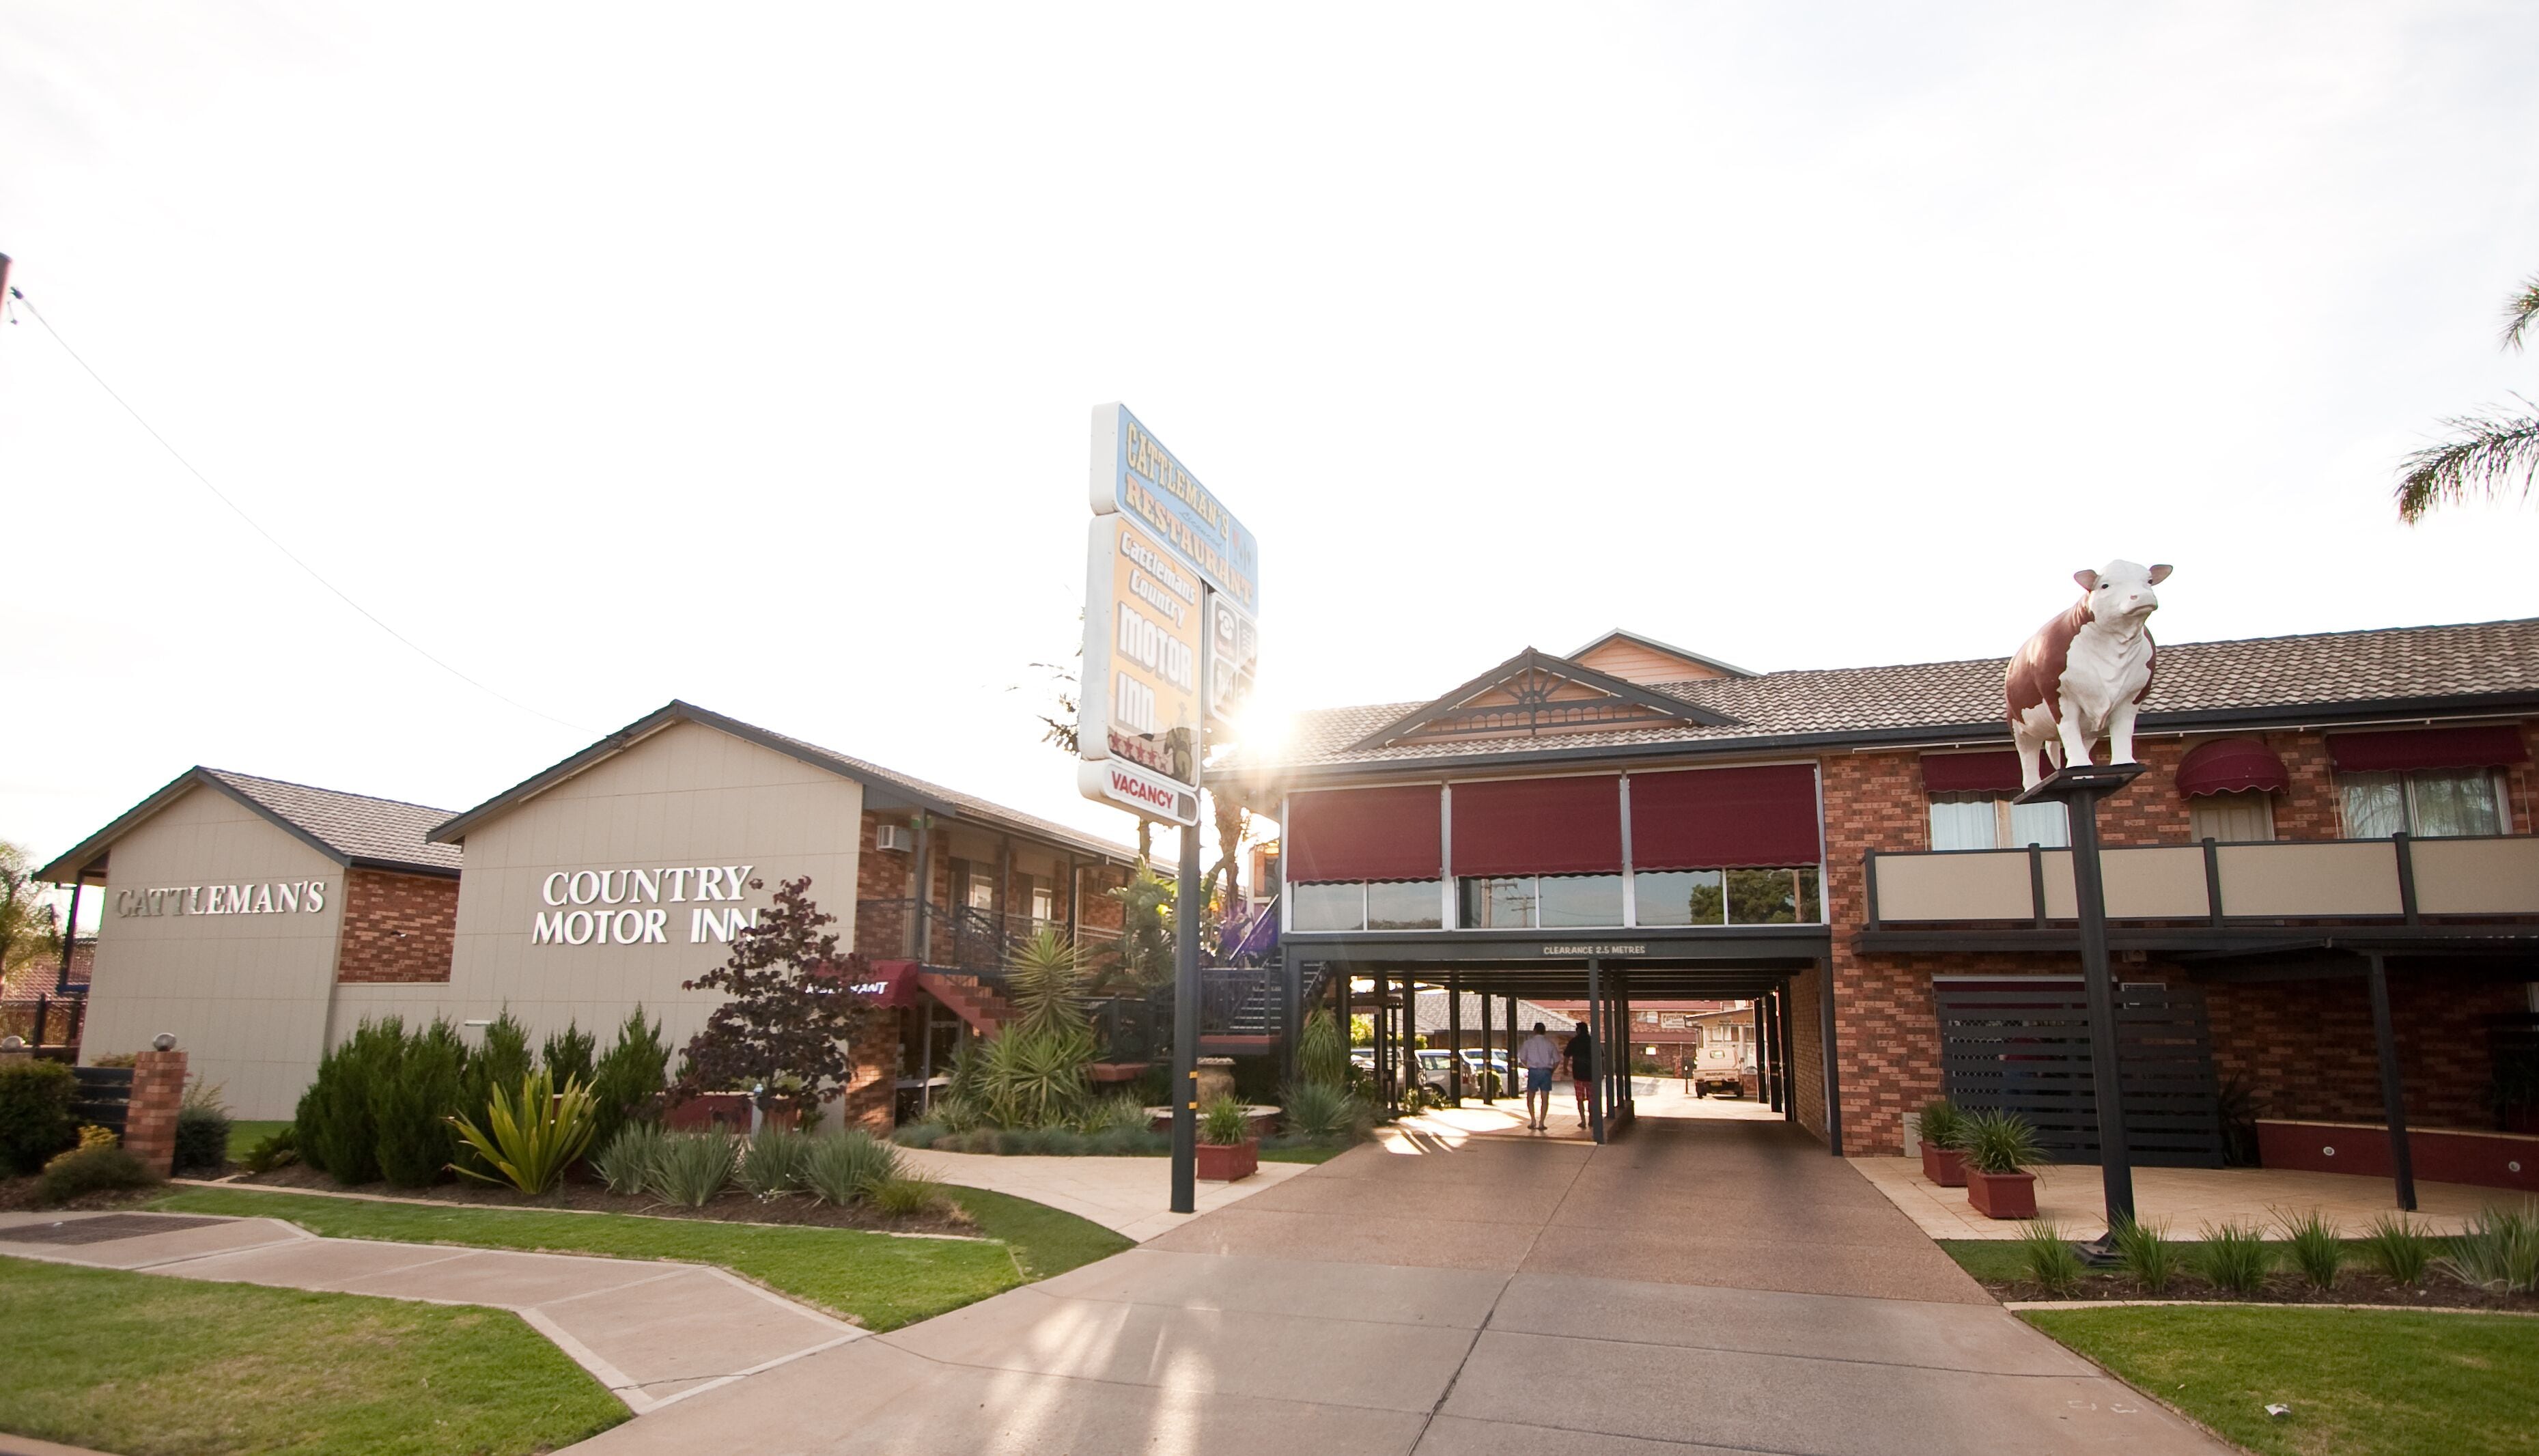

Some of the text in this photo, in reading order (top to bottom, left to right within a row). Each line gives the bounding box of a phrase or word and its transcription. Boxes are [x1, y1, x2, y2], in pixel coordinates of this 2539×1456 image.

[1126, 421, 1229, 540] CATTLEMAN'S
[1125, 472, 1254, 605] RESTAURANT
[1120, 531, 1196, 606] Cattlemans
[1129, 568, 1186, 629] Country
[1111, 770, 1174, 810] VACANCY
[115, 881, 327, 917] CATTLEMAN'S
[542, 865, 755, 906] COUNTRY
[531, 907, 759, 945] MOTOR INN
[1543, 946, 1593, 954] CLEARANCE
[1612, 945, 1645, 953] METRES
